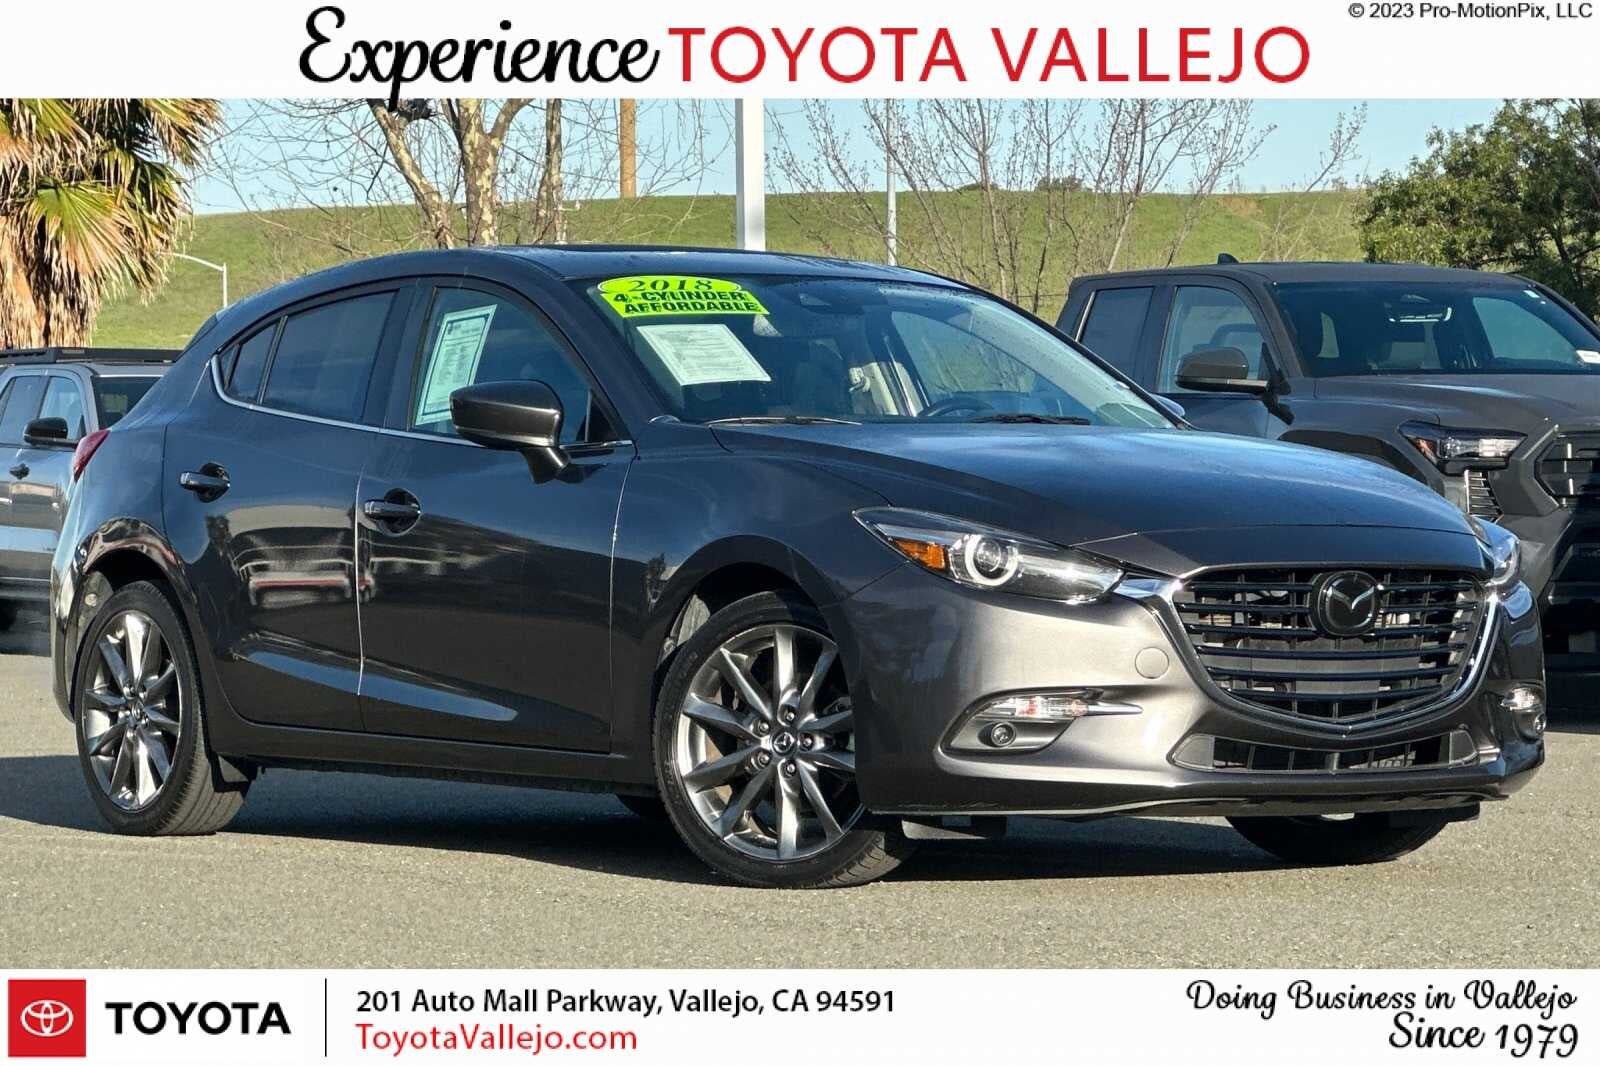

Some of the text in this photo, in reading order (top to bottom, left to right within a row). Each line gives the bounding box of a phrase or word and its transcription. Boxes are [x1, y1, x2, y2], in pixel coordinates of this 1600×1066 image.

[628, 279, 713, 291] 2018
[613, 290, 747, 303] 4-CYLINDER
[625, 301, 759, 314] AFFORDABLE
